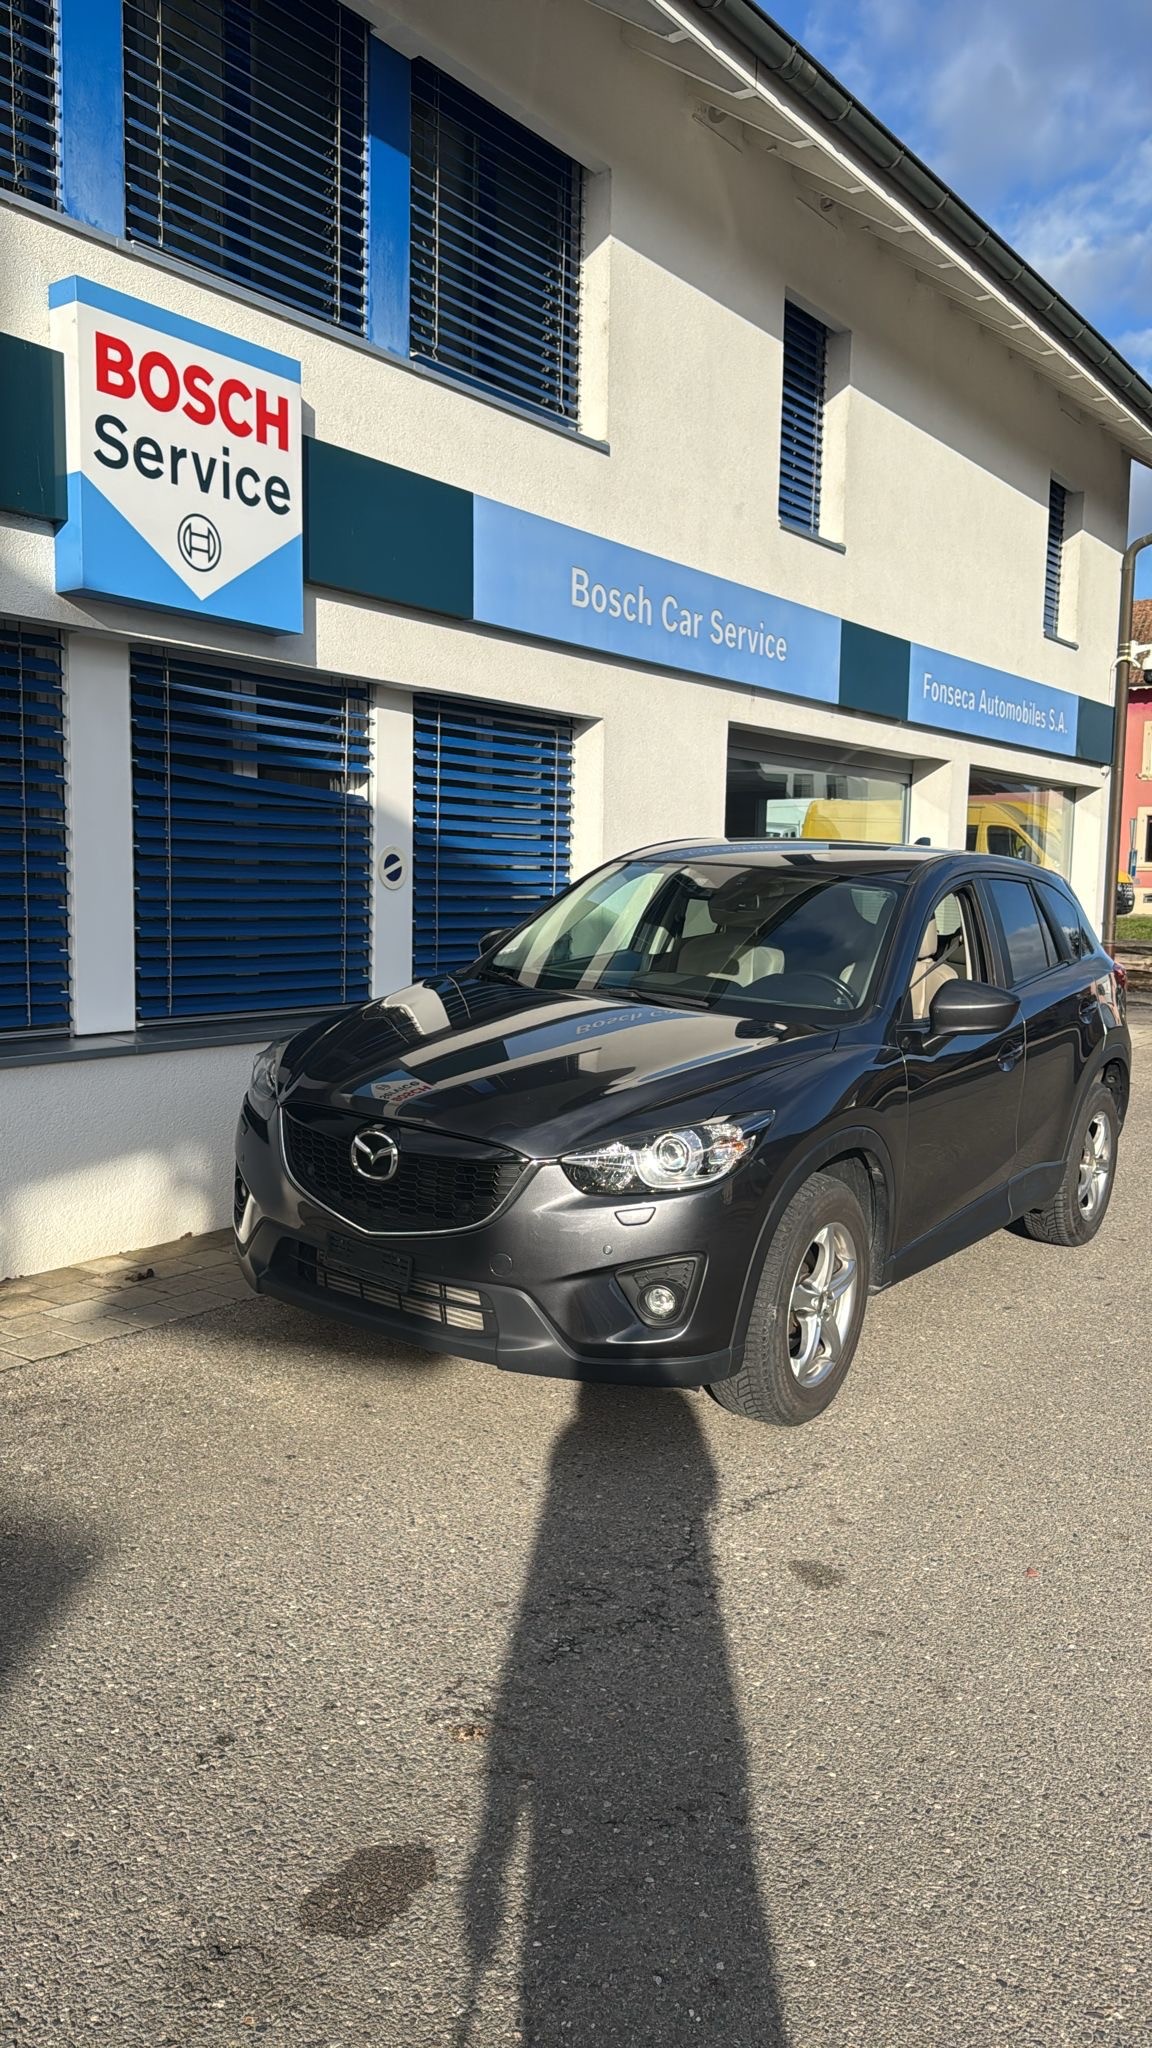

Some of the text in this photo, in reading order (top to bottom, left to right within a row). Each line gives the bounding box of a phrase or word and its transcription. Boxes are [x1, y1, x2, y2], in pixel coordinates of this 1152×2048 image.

[95, 331, 289, 452] BOSCH
[93, 413, 291, 515] Service
[571, 565, 787, 662] Bosch Car Service
[923, 672, 1068, 734] Fonseca Automobiles S.A.
